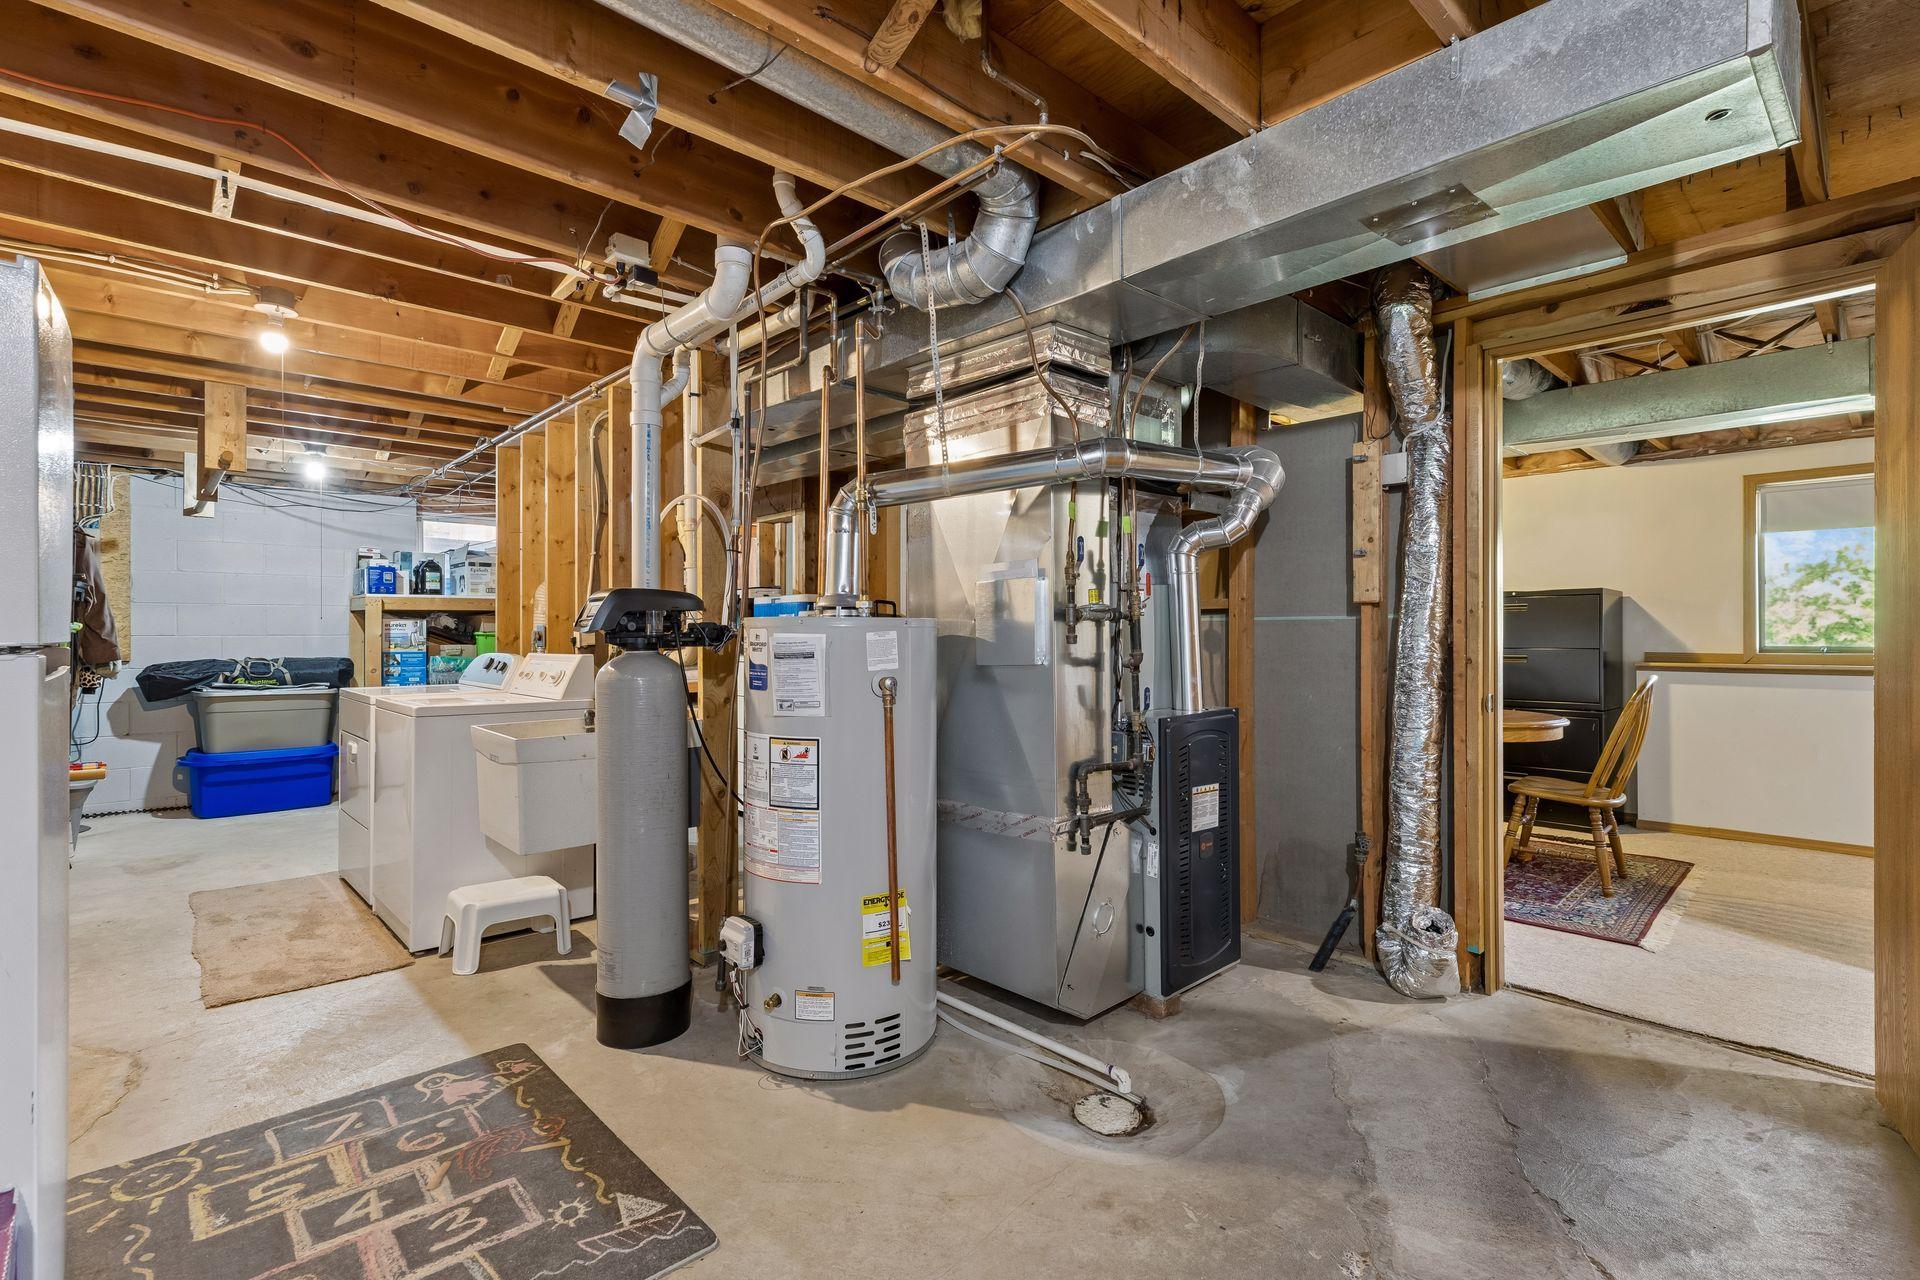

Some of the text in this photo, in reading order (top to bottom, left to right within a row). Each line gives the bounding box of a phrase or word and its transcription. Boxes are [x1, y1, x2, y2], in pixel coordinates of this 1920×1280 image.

[397, 1130, 447, 1152] 6
[245, 1163, 320, 1212] 5
[333, 1189, 394, 1227] 4
[427, 1206, 488, 1251] 3
